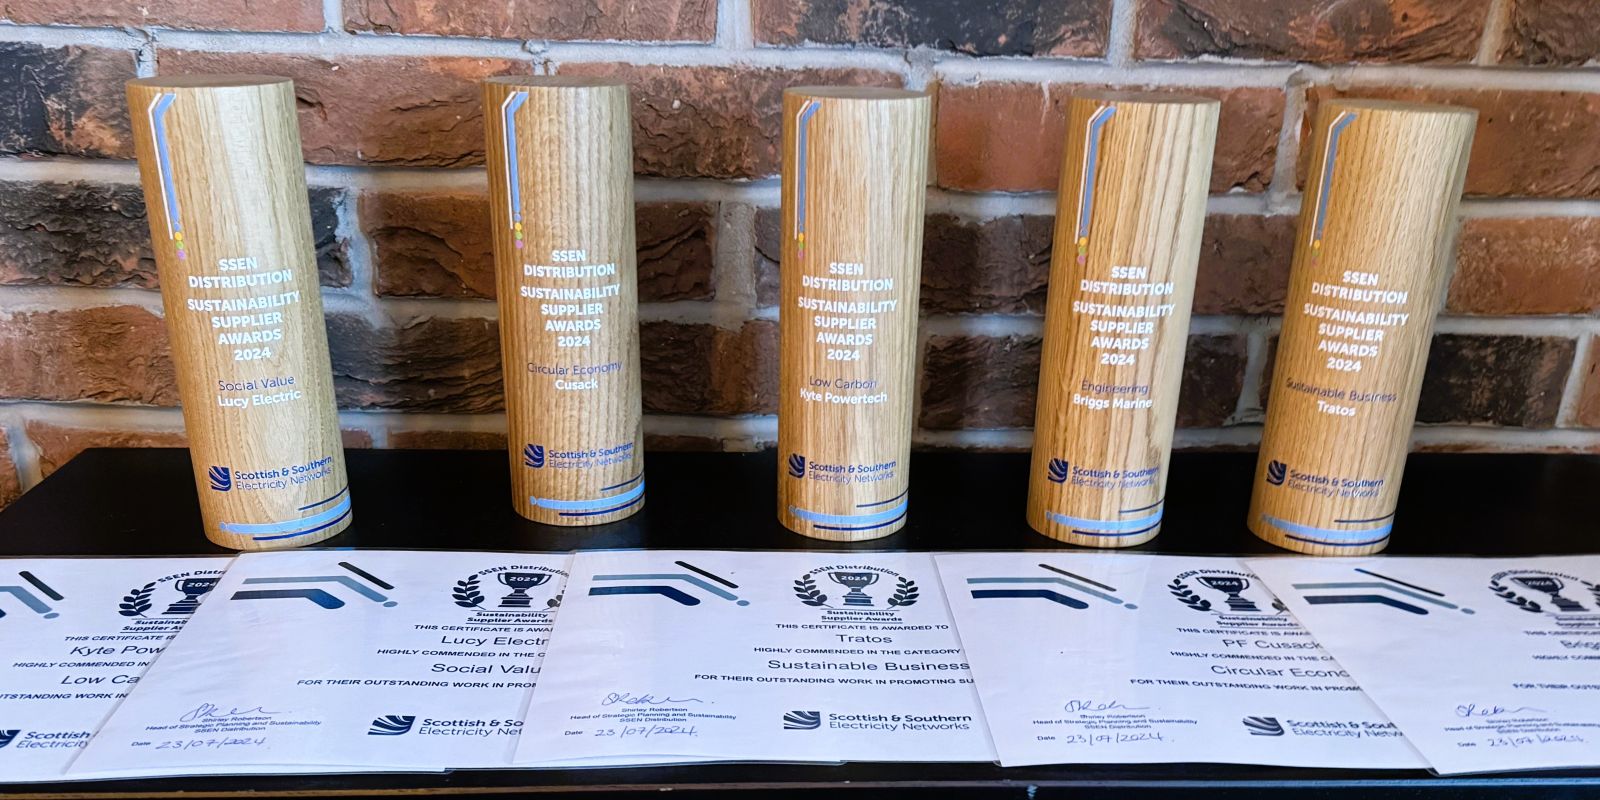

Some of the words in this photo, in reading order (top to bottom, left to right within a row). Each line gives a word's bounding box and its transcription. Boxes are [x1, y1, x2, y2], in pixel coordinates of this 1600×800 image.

[551, 250, 586, 262] SSEN
[219, 257, 257, 271] SSEN
[524, 263, 615, 278] DISTRIBUTION
[830, 262, 864, 275] SSEN
[189, 269, 292, 288] DISTRIBUTION
[1111, 266, 1147, 279] SSEN
[1343, 270, 1378, 286] SSEN
[802, 275, 894, 292] DISTRIBUTION
[1080, 280, 1174, 295] DISTRIBUTION
[521, 284, 620, 300] SUSTAINABILITY
[1312, 282, 1408, 304] DISTRIBUTION
[188, 291, 299, 311] SUSTAINABILITY
[798, 296, 897, 314] SUSTAINABILITY
[541, 303, 603, 316] SUPPLIER
[1073, 301, 1176, 318] SUSTAINABILITY
[1304, 303, 1409, 326] SUSTAINABILITY
[212, 312, 282, 328] SUPPLIER
[545, 319, 601, 332] AWARDS
[814, 316, 876, 330] SUPPLIER
[1090, 320, 1154, 334] SUPPLIER
[1318, 323, 1384, 342] SUPPLIER
[218, 329, 282, 345] AWARDS
[558, 336, 590, 347] 2024
[816, 332, 873, 345] AWARDS
[1091, 336, 1149, 350] AWARDS
[234, 347, 272, 361] 2024
[827, 349, 860, 361] 2024
[1318, 340, 1378, 357] AWARDS
[1101, 353, 1135, 366] 2024
[1327, 357, 1362, 372] 2024
[527, 362, 569, 375] Circular
[573, 361, 623, 376] Economy
[219, 380, 257, 392] Social
[261, 375, 295, 389] Value
[555, 378, 598, 390] Cusack
[810, 376, 832, 388] Low
[835, 378, 877, 389] Carbon
[1082, 380, 1148, 395] Engineering
[800, 388, 822, 402] Kyte
[825, 392, 887, 404] Powertech
[1286, 377, 1345, 399] Sustainable
[1349, 390, 1397, 402] Business
[218, 395, 248, 409] Lucy
[252, 389, 301, 405] Electric
[1073, 394, 1109, 410] Briggs
[1112, 399, 1152, 408] Marine
[1317, 400, 1356, 416] Tratos
[549, 450, 588, 459] Scottish
[590, 449, 596, 457] &
[235, 470, 279, 480] Scottish
[282, 467, 289, 476] &
[292, 456, 332, 474] Southern
[549, 459, 593, 469] Electricity
[809, 461, 846, 473] Scottish
[848, 465, 855, 473] &
[858, 461, 896, 473] Southern
[809, 471, 851, 485] Electricity
[854, 472, 894, 483] Networks
[1073, 466, 1111, 477] Scottish
[236, 477, 287, 491] Electricity
[290, 466, 331, 486] Networks
[1072, 476, 1115, 489] Electricity
[1290, 470, 1329, 485] Scottish
[1332, 478, 1338, 486] &
[1341, 478, 1383, 487] Southern
[1288, 480, 1332, 497] Electricity
[810, 566, 835, 575] SSEN
[836, 565, 900, 577] Distribution
[441, 636, 487, 646] Lucy
[493, 636, 550, 646] Electr
[835, 634, 893, 644] Tratos
[1223, 639, 1248, 648] PF
[1254, 639, 1323, 650] Cusack
[70, 646, 115, 655] Kyte
[1211, 653, 1282, 661] COMMENDED
[431, 663, 493, 674] Social
[500, 664, 542, 674] Valu
[767, 660, 878, 671] Sustainable
[884, 661, 971, 671] Business
[1210, 665, 1284, 677] Circular
[61, 675, 106, 684] Low
[364, 679, 448, 687] OUTSTANDING
[422, 719, 486, 727] Scottish
[829, 713, 889, 722] Scottish
[891, 714, 902, 722] &
[904, 714, 972, 722] Southern
[1287, 719, 1347, 729] Scottish
[419, 727, 490, 738] Electricity
[829, 721, 898, 732] Electricity
[902, 722, 970, 731] Networks
[1292, 728, 1362, 738] Electricity
[16, 740, 88, 749] Electricity
